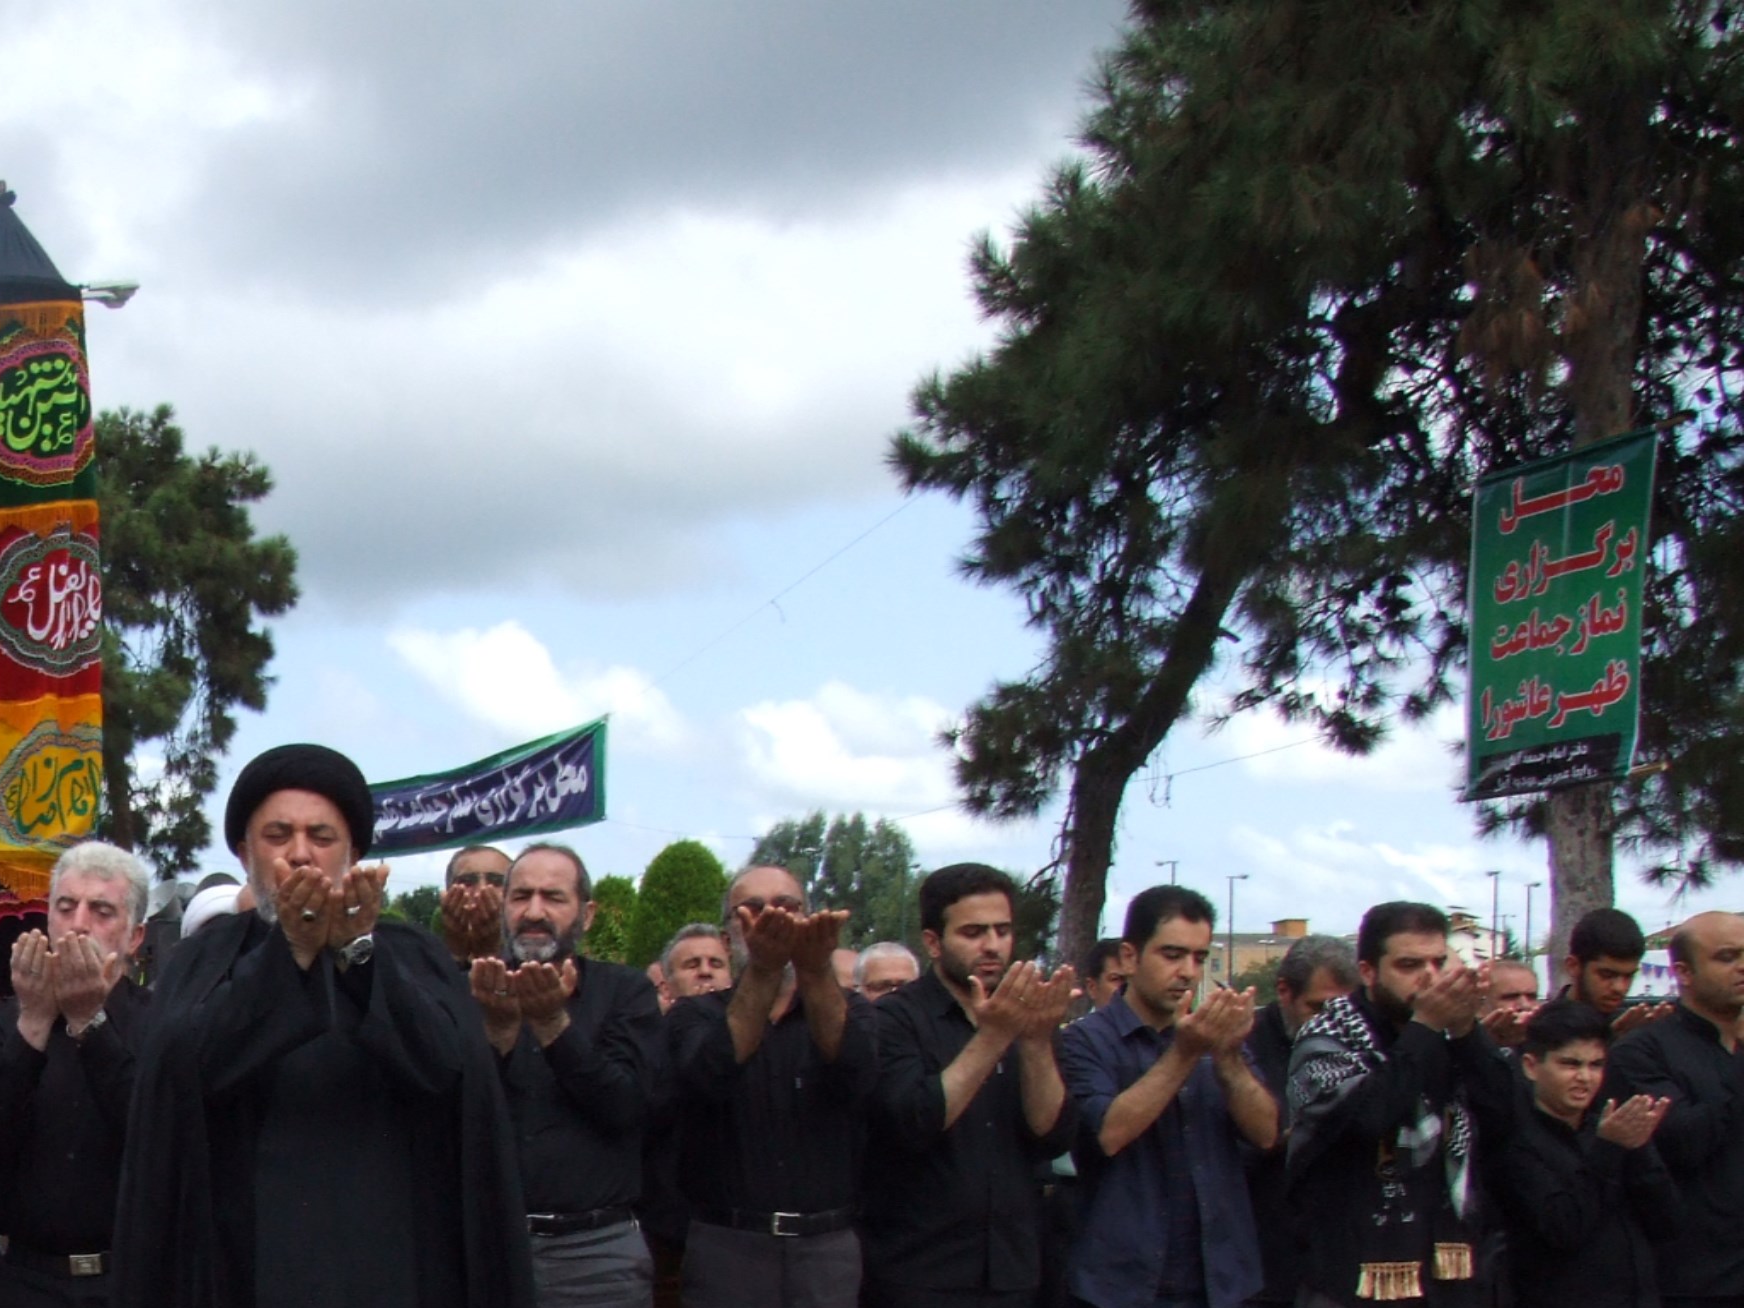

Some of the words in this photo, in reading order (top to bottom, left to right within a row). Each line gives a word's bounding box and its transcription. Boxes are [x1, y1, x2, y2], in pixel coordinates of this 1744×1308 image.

[1499, 464, 1624, 535] محل
[1494, 519, 1638, 604] برگزاری
[1490, 607, 1574, 661] جماعت
[1568, 587, 1628, 656] نماز
[1481, 675, 1552, 741] عاشورا
[1546, 659, 1630, 728] ظهر
[397, 793, 448, 833] جماعت
[445, 779, 478, 833] نماز
[475, 764, 546, 827] برگزاری
[545, 752, 588, 813] محل
